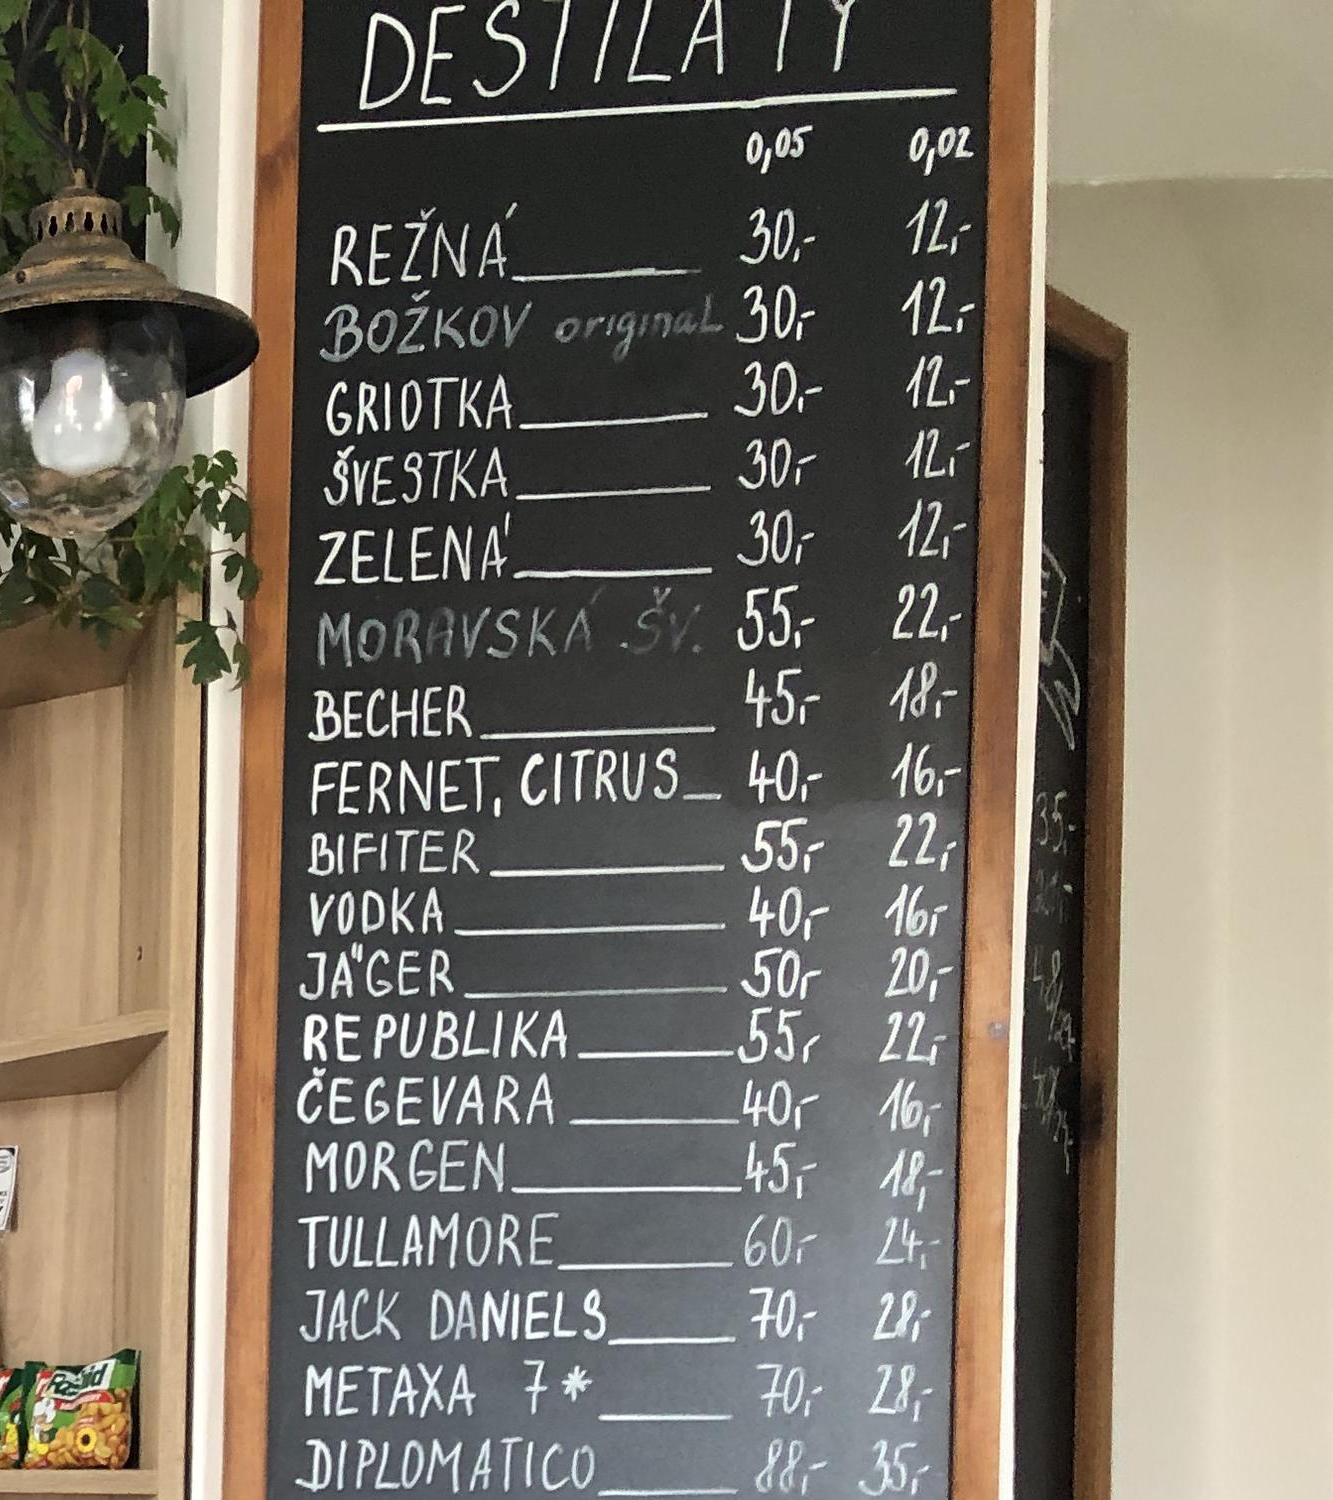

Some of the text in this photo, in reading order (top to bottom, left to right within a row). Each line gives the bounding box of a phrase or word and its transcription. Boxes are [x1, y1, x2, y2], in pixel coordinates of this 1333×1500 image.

[745, 125, 975, 175] 0,05 0,02
[331, 202, 516, 286] REŽNÁ
[320, 290, 532, 363] BOŽKOV
[324, 375, 513, 437] GRIOTKA
[323, 445, 509, 507] ŠVESTKA
[314, 512, 513, 587] ZELENÁ
[316, 586, 607, 670] MORAVSKÁ
[309, 684, 473, 742] BECHER
[310, 755, 502, 818] FERNET,
[520, 747, 680, 807] CITRUS
[308, 828, 480, 877] BIFITER
[308, 886, 444, 938] VODKA
[299, 943, 456, 1000] JÄGER
[303, 1008, 569, 1064] REPUBLIKA
[297, 1067, 556, 1128] ČEGEVARA
[306, 1140, 507, 1194] MORGEN
[298, 1211, 560, 1270] TULLAMORE
[299, 1288, 404, 1343] JACK
[431, 1288, 609, 1343] DANIELS
[304, 1363, 477, 1418] METAXA
[295, 1438, 596, 1493] DIPLOMATICO
